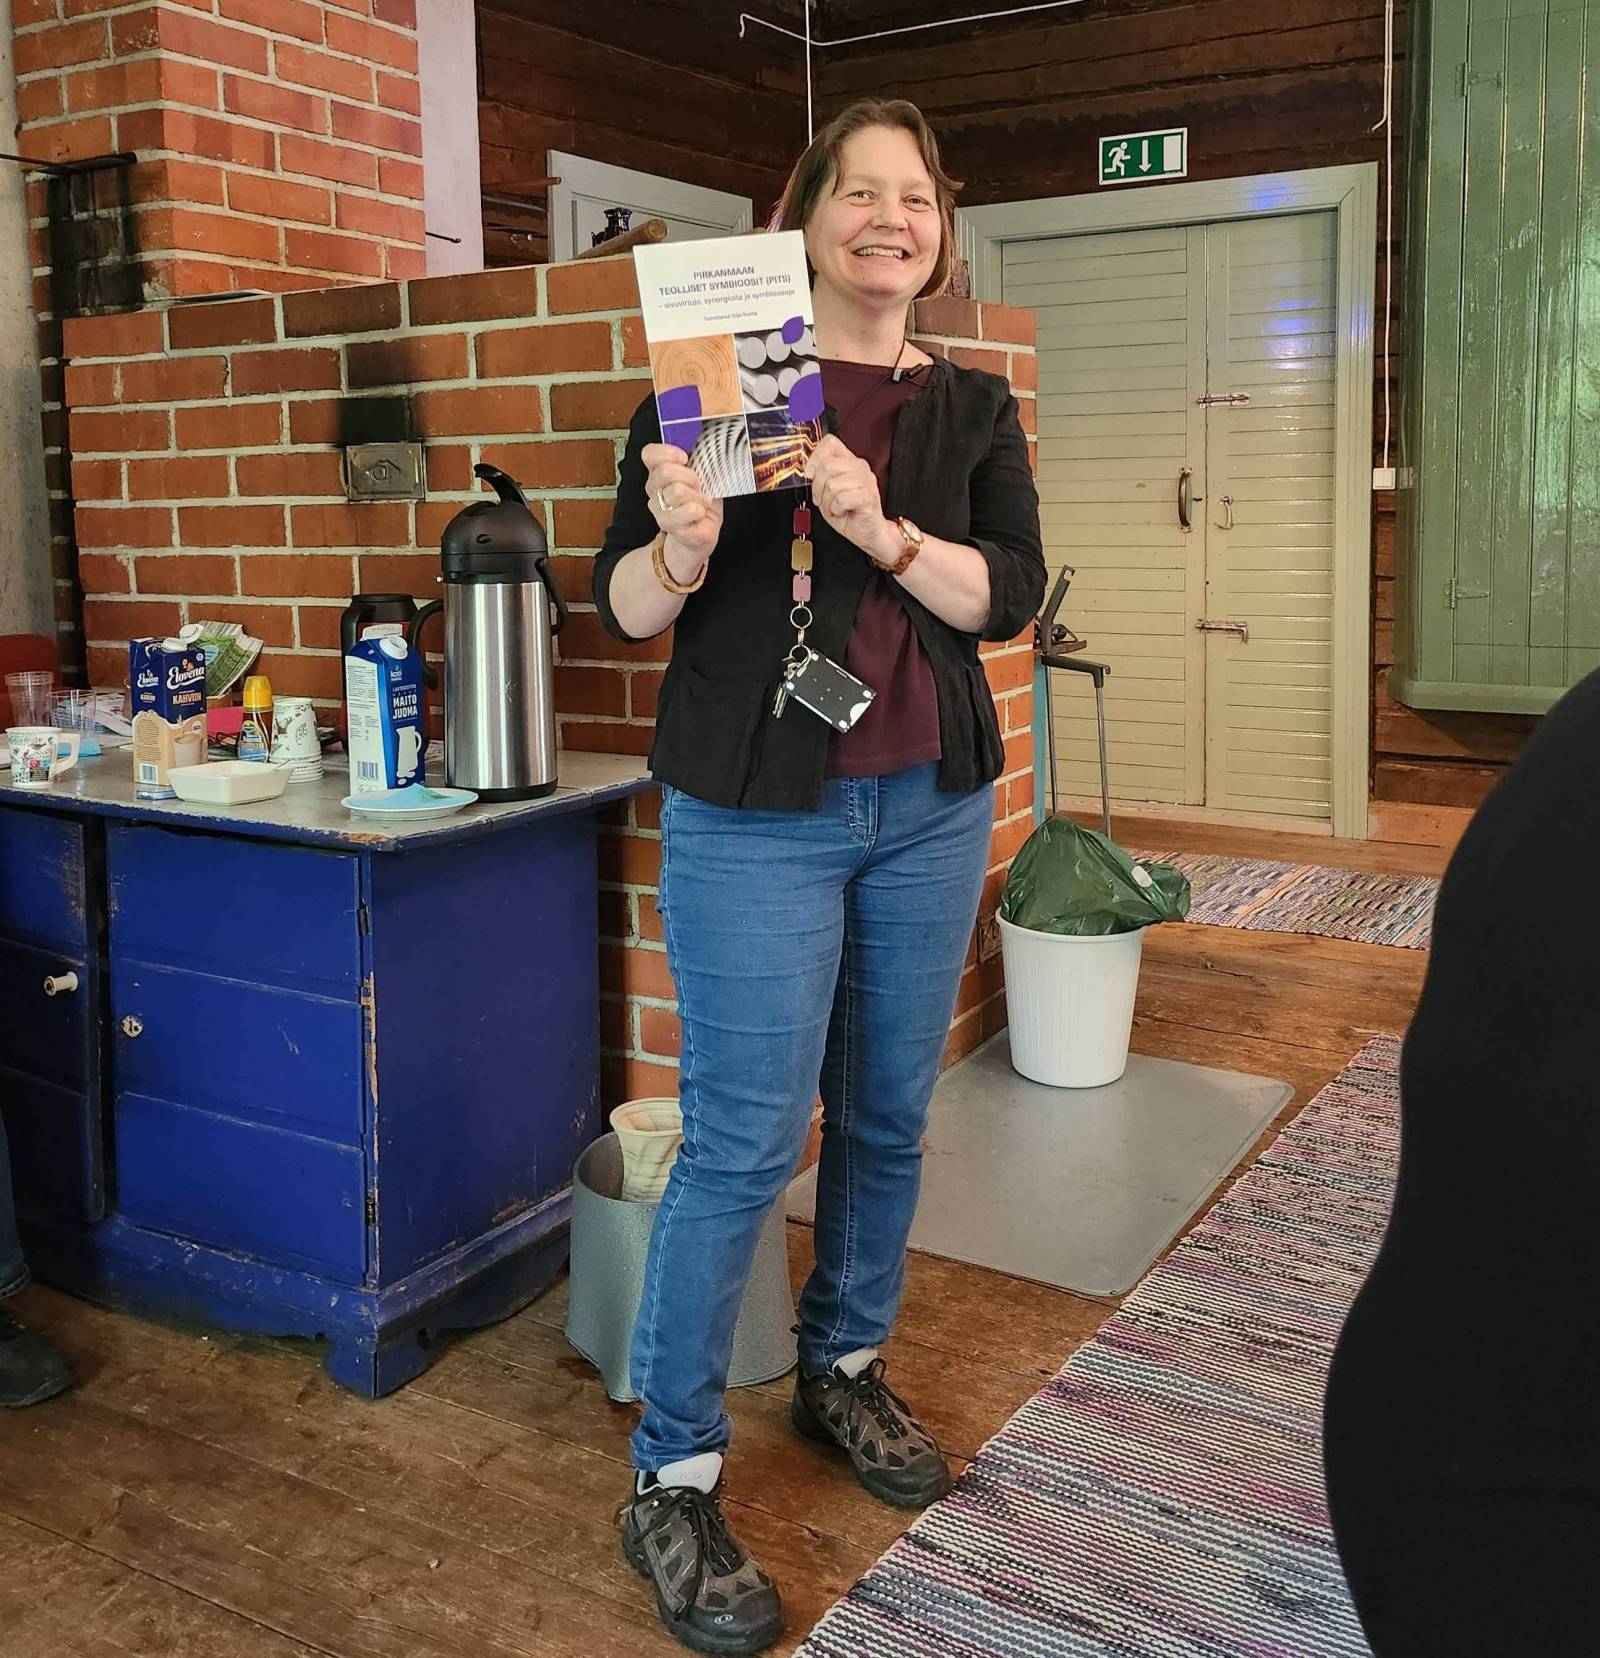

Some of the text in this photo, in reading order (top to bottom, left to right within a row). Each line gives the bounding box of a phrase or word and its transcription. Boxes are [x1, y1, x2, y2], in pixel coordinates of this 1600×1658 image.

[693, 266, 755, 281] PIRKANMAAN
[658, 274, 791, 297] TEOLLISET SYMBIOOSIT (PITS)
[166, 665, 206, 690] Elovena
[393, 694, 417, 708] MAITO
[392, 705, 418, 720] JUOMA
